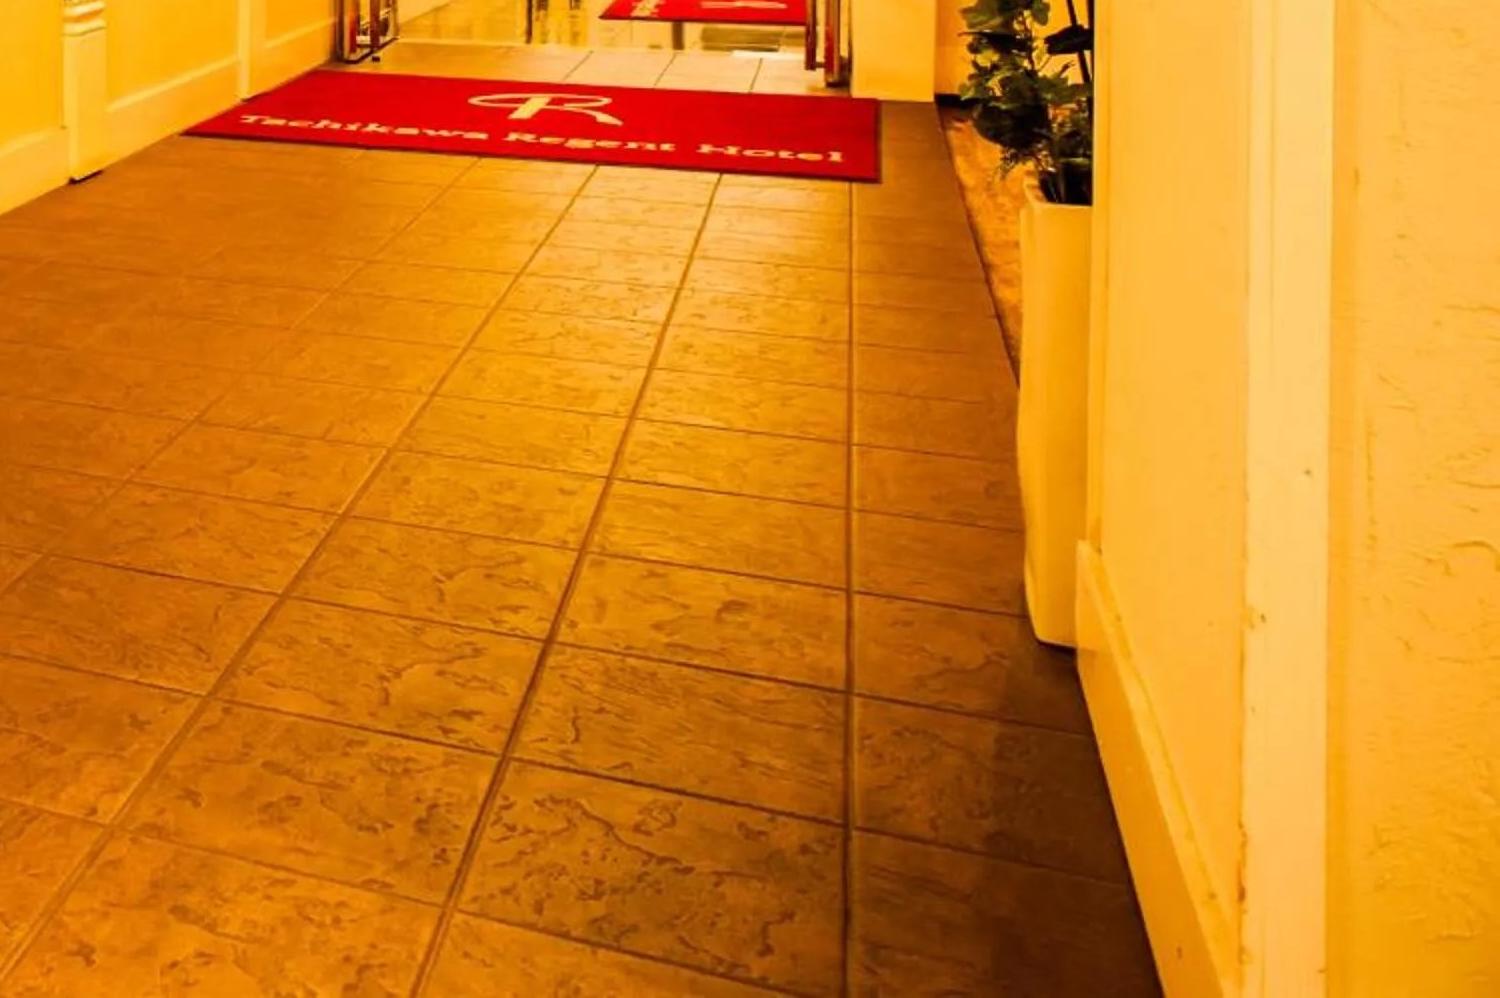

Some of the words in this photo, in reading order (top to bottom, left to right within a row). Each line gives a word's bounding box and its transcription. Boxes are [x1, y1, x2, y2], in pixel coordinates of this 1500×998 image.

[238, 113, 490, 140] Tachikawa
[502, 131, 677, 152] Regent
[696, 144, 844, 163] Hotel
